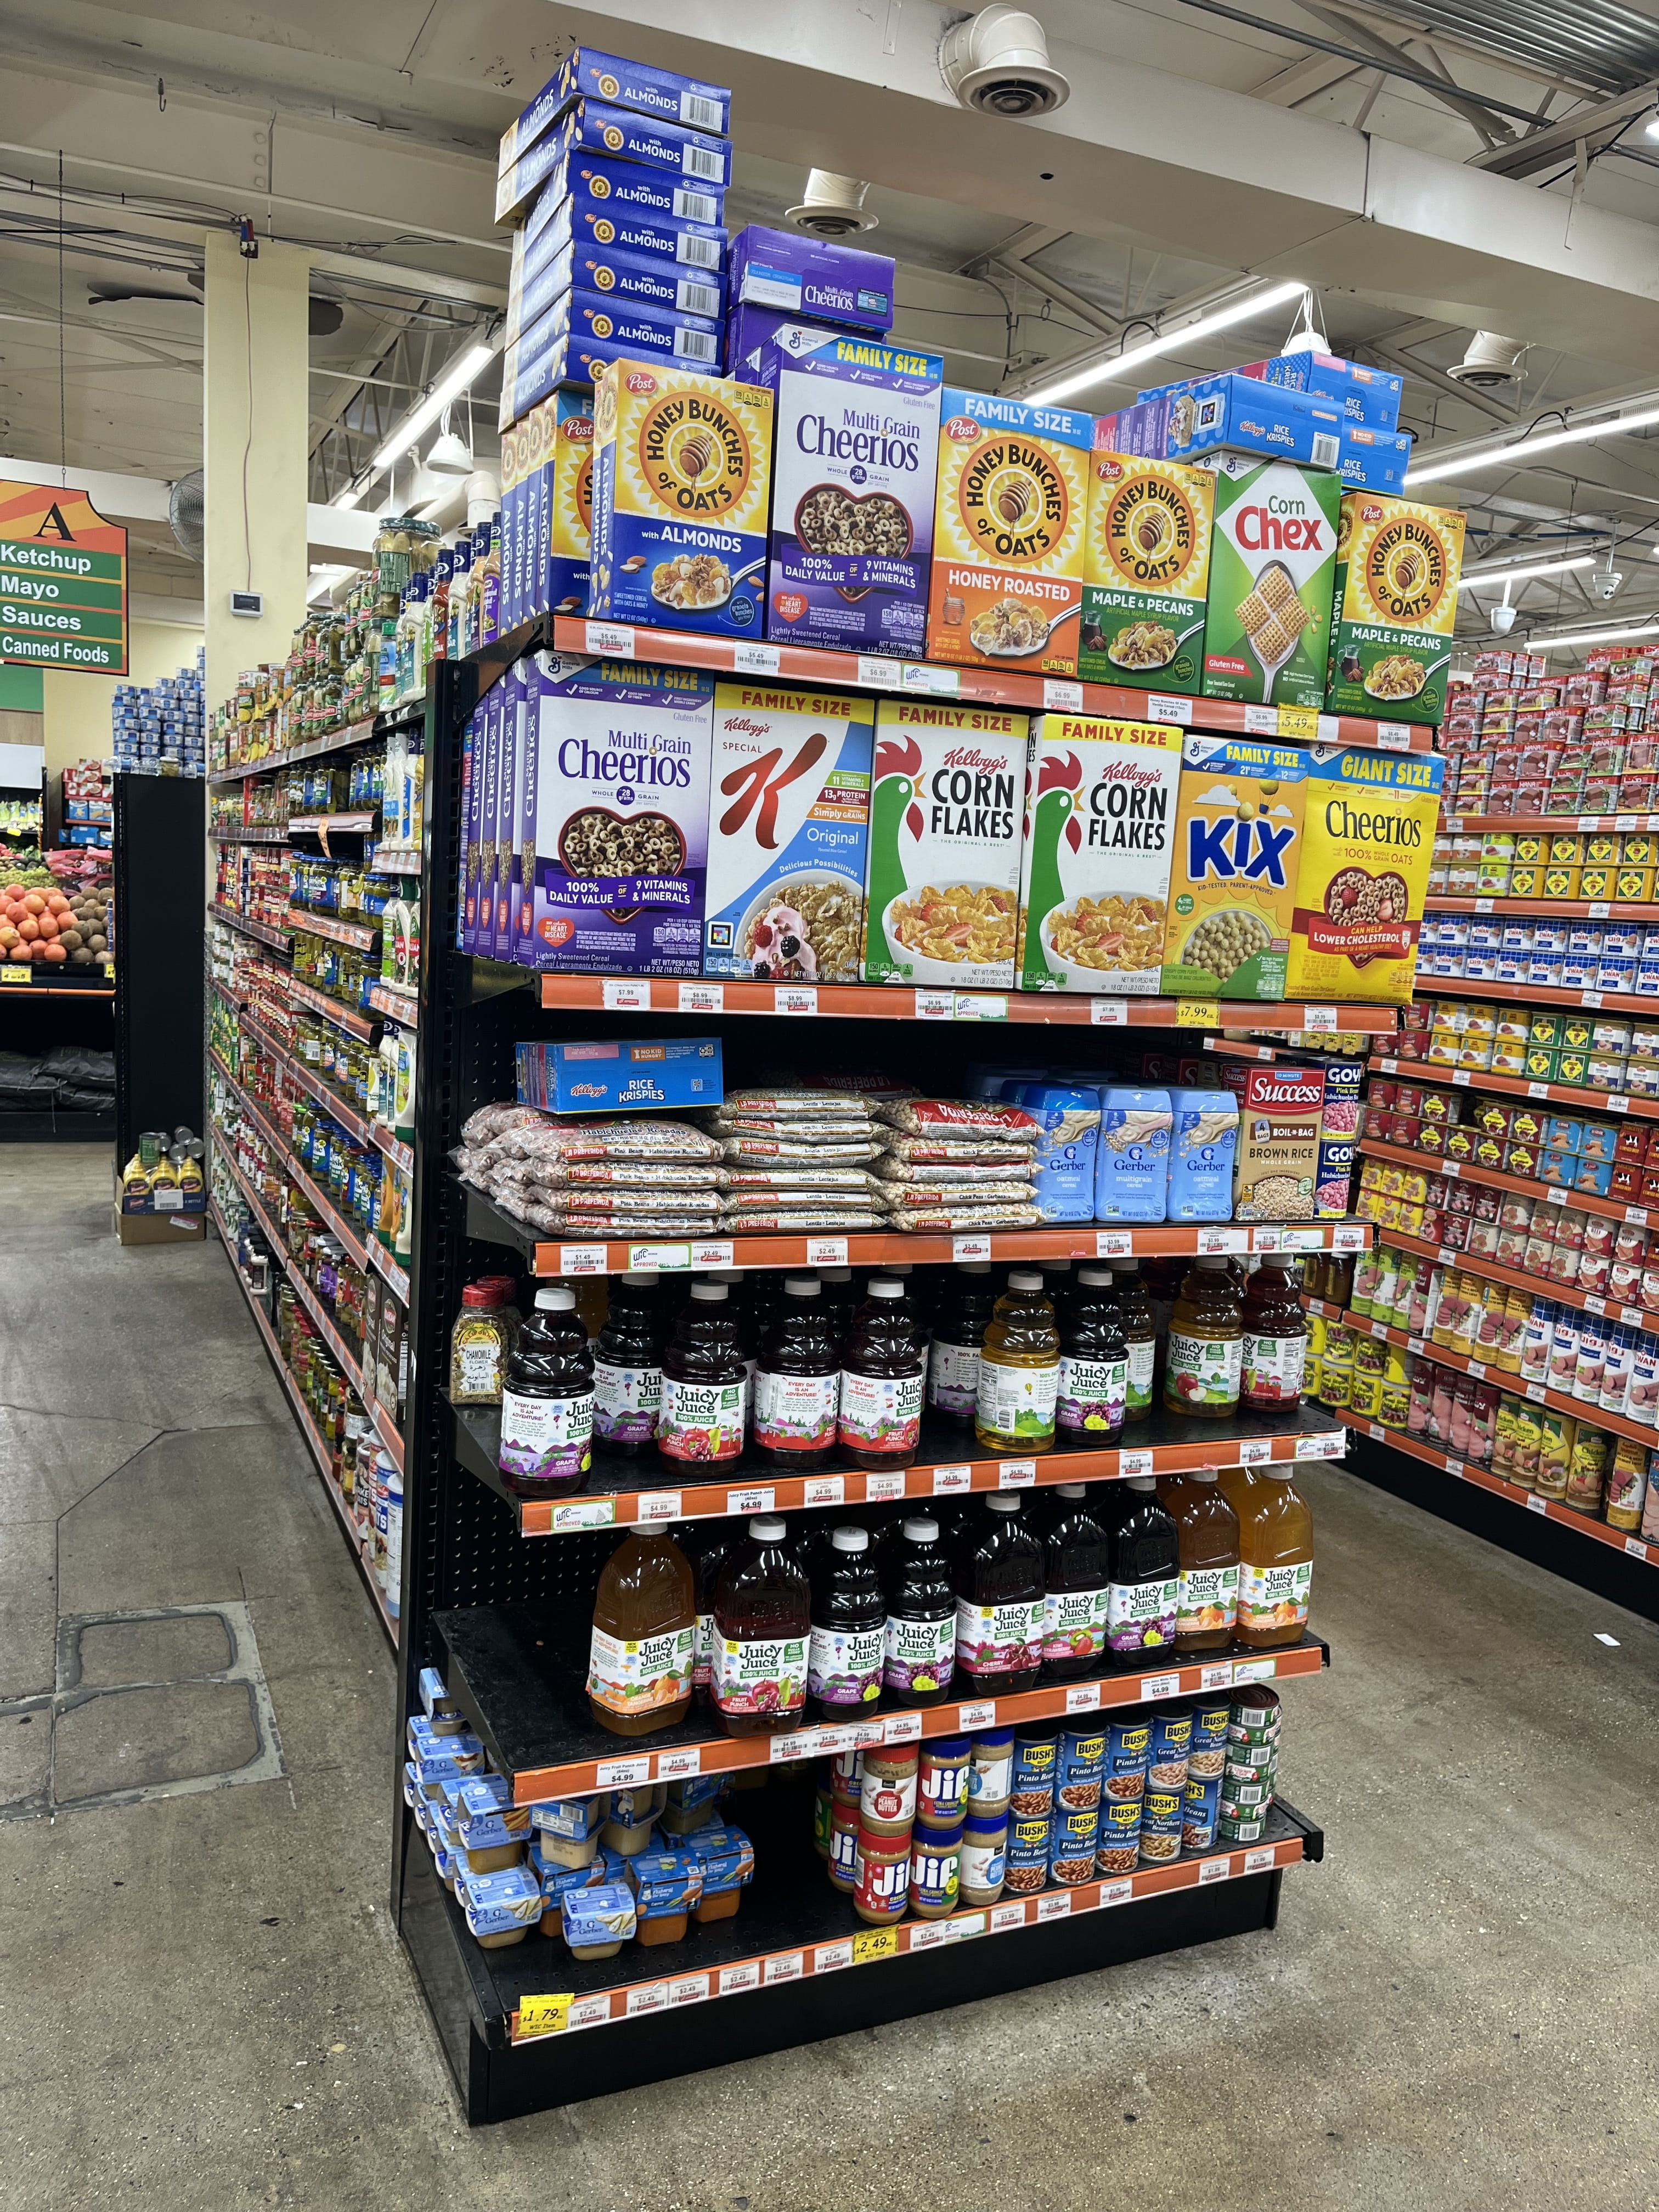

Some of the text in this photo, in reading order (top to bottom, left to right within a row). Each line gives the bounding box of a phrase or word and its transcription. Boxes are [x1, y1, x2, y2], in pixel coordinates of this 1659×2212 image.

[625, 87, 678, 111] ALMONDS
[629, 138, 680, 162] ALMONDS
[616, 186, 670, 208] ALMONDS
[805, 286, 853, 311] Cheerios
[618, 325, 672, 346] ALMONDS
[837, 342, 927, 376] FAMILY SIZE
[628, 374, 653, 388] Post
[843, 409, 920, 439] Multi Grain
[964, 399, 1072, 433] FAMILY SIZE
[647, 398, 742, 477] HONEY BUNCHES
[949, 421, 975, 436] Post
[1240, 421, 1264, 437] Kellogg's
[1266, 431, 1294, 447] KRISPIES
[1274, 424, 1289, 435] RICE
[797, 414, 919, 472] Cheerios
[1100, 462, 1120, 476] Post
[658, 473, 732, 511] of OATS
[967, 444, 1060, 521] HONEY BUNCHES
[1111, 482, 1188, 549] HONEY BUNCHES
[1269, 495, 1305, 515] Corn
[33, 502, 77, 541] A
[1235, 506, 1322, 550] Chex
[642, 526, 742, 553] with ALMONDS
[978, 519, 1050, 556] of OATS
[1, 545, 91, 574] Ketchup
[801, 558, 832, 569] 100%
[866, 561, 914, 576] 9 VITAMINS
[1120, 548, 1180, 580] of OATS
[786, 567, 845, 581] DAILY VALUE
[862, 572, 916, 589] & MINERALS
[2, 575, 59, 600] Mayo
[949, 569, 1070, 601] HONEY ROASTED
[1092, 591, 1193, 617] MAPLE & PECANS
[2, 606, 81, 630] Sauces
[3, 636, 109, 663] Canned Foods
[1352, 628, 1441, 650] MAPLE & PECANS
[1209, 659, 1244, 670] Gluten Free
[601, 663, 698, 691] FAMILY SIZE
[742, 691, 851, 716] FAMILY SIZE
[1159, 709, 1178, 718] $5.49
[724, 718, 770, 736] Kellogg's
[899, 707, 1012, 732] FAMILY SIZE
[608, 730, 691, 754] Multi Grain
[1062, 722, 1166, 746] FAMILY SIZE
[723, 742, 761, 753] SPECIAL
[1227, 746, 1298, 768] FAMILY SIZE
[558, 738, 690, 788] Cheerios
[944, 747, 1007, 774] Kellogg's
[1103, 761, 1162, 786] Kellogg's
[1341, 758, 1431, 787] GIANT SIZE
[720, 733, 827, 849] K
[824, 789, 865, 800] 13g PROTEIN
[932, 769, 1014, 809] CORN
[1090, 783, 1167, 820] CORN
[814, 807, 865, 820] Simply GRAINS
[932, 806, 1013, 839] FLAKES
[1325, 800, 1421, 848] Cheerios
[807, 828, 859, 845] Original
[1088, 820, 1165, 849] FLAKES
[1344, 848, 1372, 860] 100%
[1390, 854, 1413, 866] OATS
[779, 859, 859, 878] Delicious Possibilities
[1198, 882, 1275, 895] KID-TESTED. PARENT-APPROVED.
[1314, 933, 1400, 944] LOWER CHOLESTEROL
[536, 952, 556, 962] Lightly
[629, 1080, 654, 1091] RICE
[1329, 1068, 1360, 1082] GOY
[571, 1084, 607, 1097] Kellogg's
[619, 1089, 664, 1102] KRISPIES
[1252, 1078, 1321, 1103] Success
[573, 1146, 605, 1156] PREFERIDA
[1250, 1148, 1313, 1158] BROWN RICE
[1114, 1160, 1155, 1172] Gerber
[1116, 1175, 1152, 1183] multigrain
[462, 1331, 495, 1344] CALIFORNIA
[466, 1350, 490, 1359] CHAMOMILE
[676, 1387, 720, 1405] Juicy
[677, 1401, 715, 1413] Juice
[678, 1414, 692, 1423] 100%
[1187, 1573, 1221, 1588] Juicy
[639, 1637, 675, 1656] Juicy
[921, 1765, 969, 1800] Jif
[1146, 1796, 1179, 1808] BUSH'S
[1017, 1821, 1048, 1837] BUSH'S
